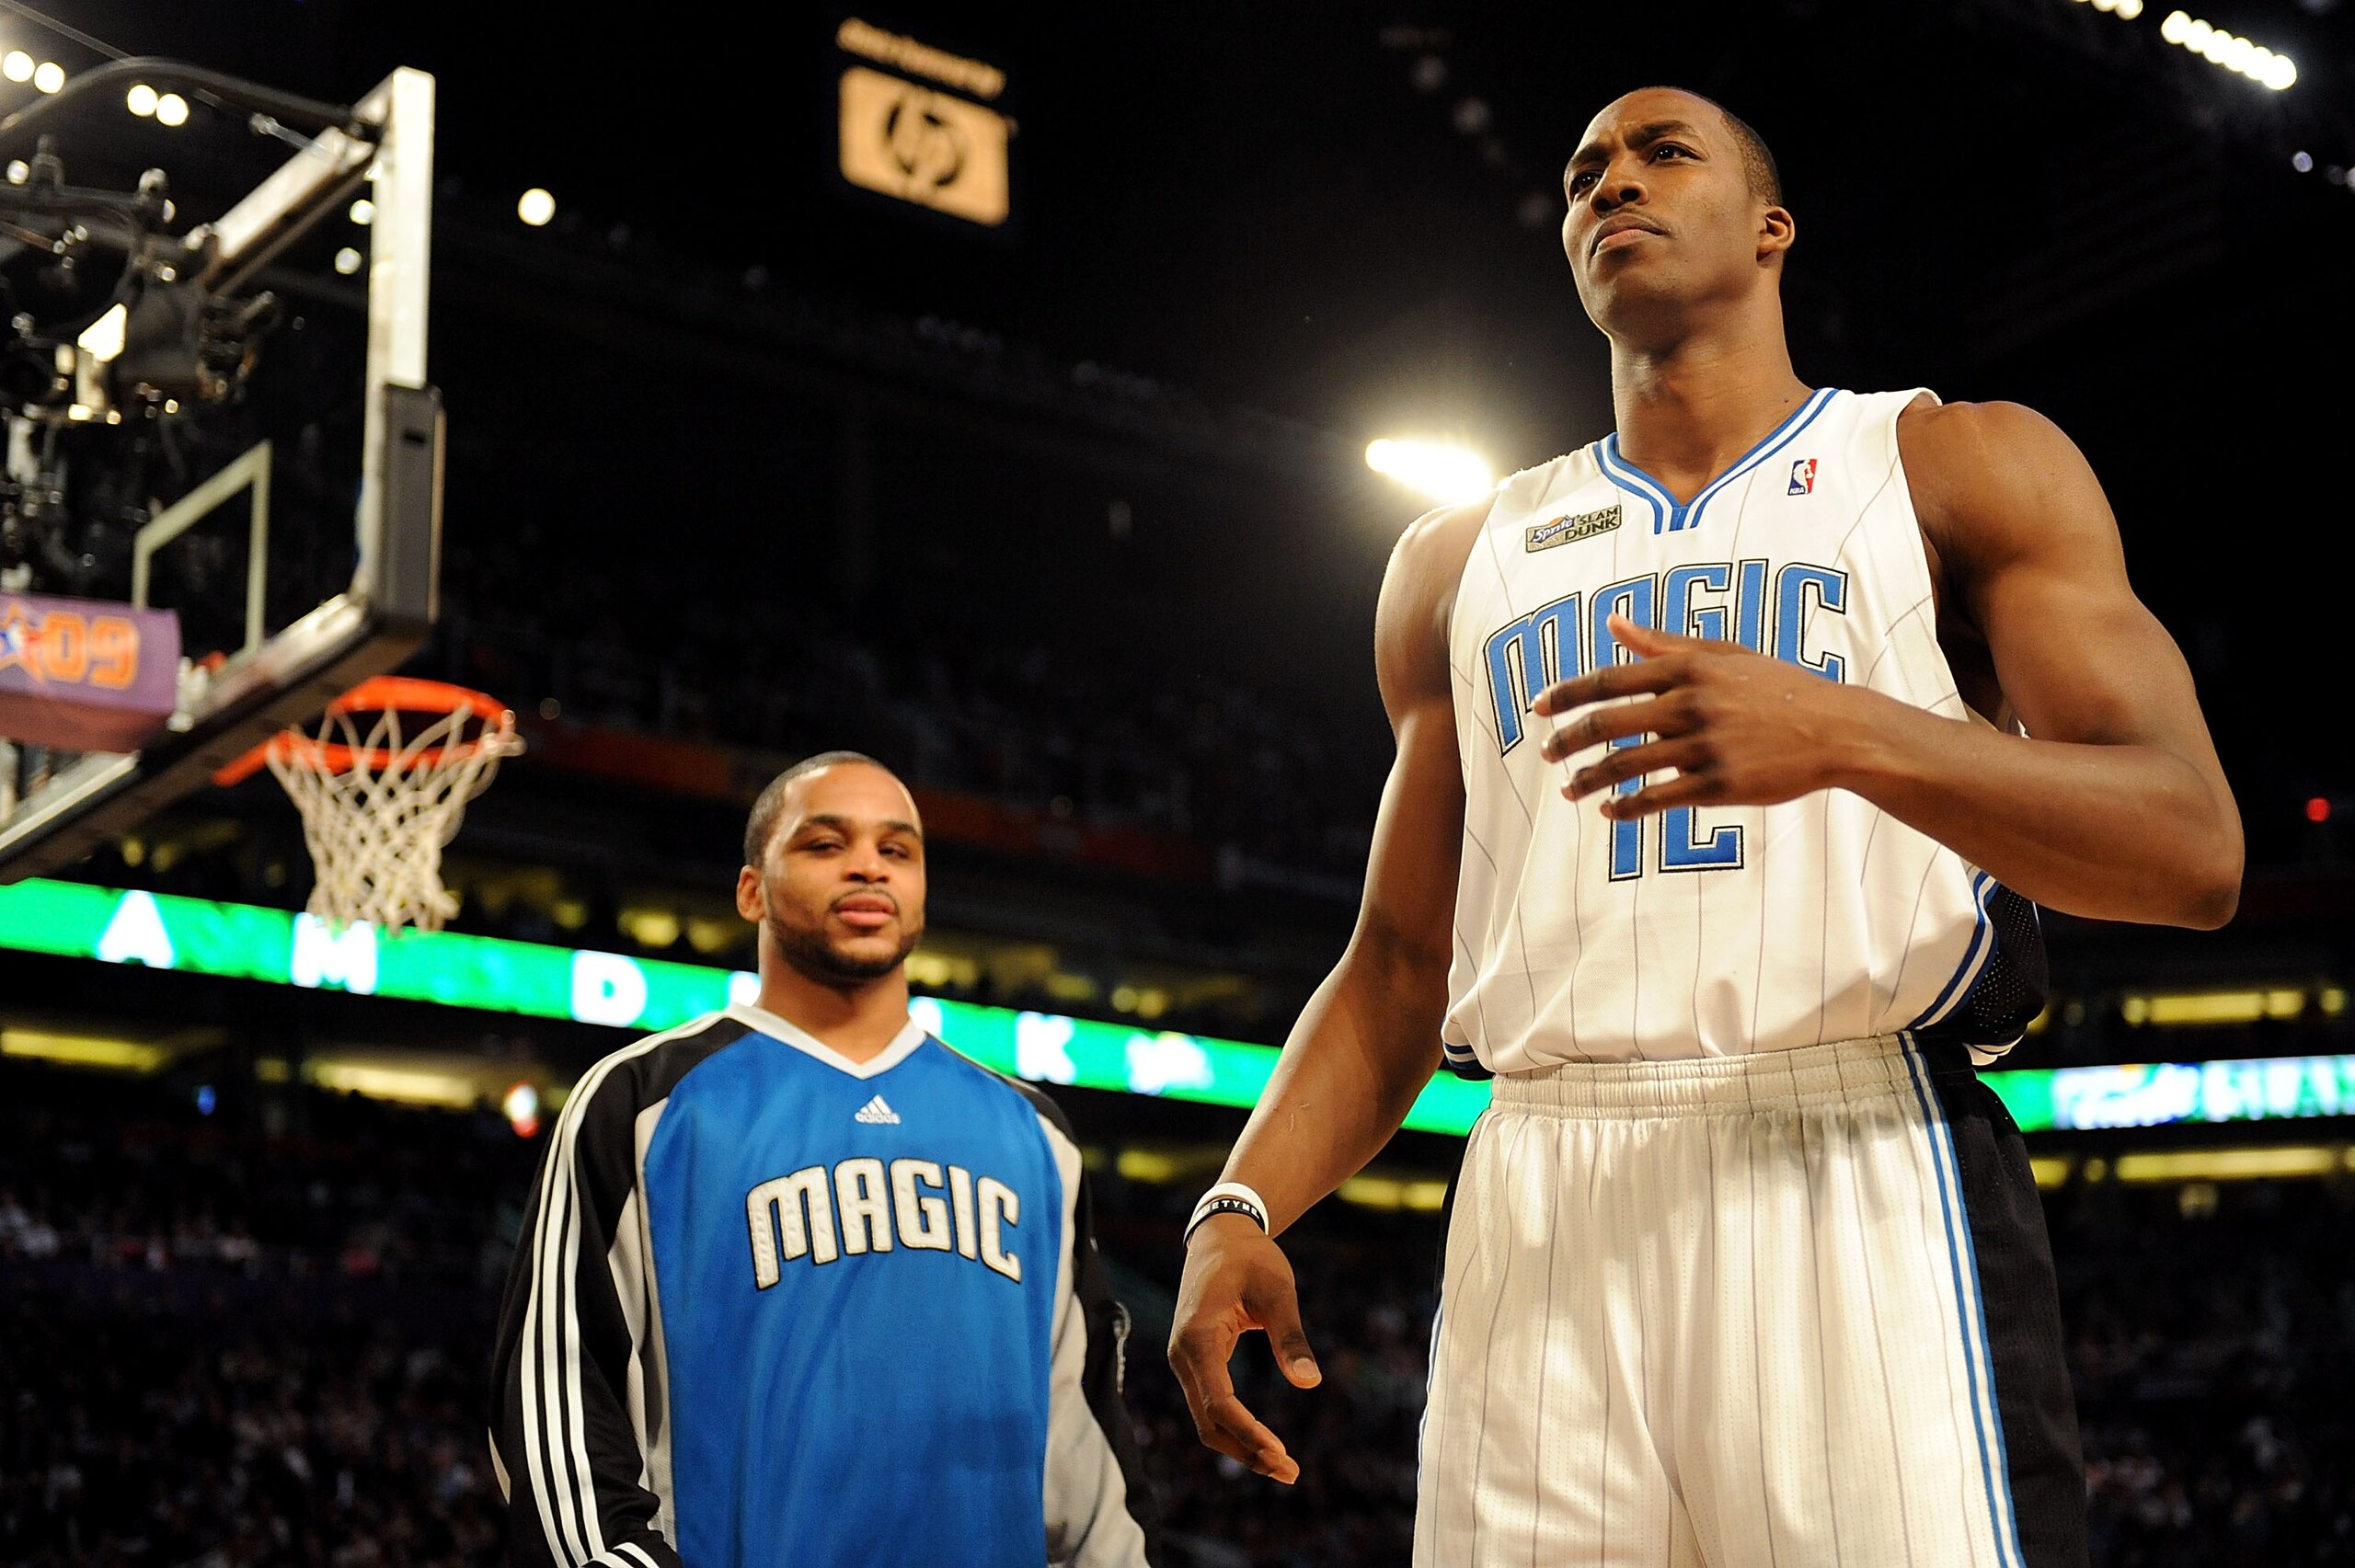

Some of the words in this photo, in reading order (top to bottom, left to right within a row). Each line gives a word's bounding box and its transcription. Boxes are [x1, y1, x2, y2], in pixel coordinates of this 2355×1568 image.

[1533, 518, 1573, 542] Sprite
[1580, 507, 1618, 525] SLAM
[1565, 516, 1617, 541] DUNK
[43, 610, 140, 691] 09
[1483, 558, 1848, 758] MAGIC
[855, 1111, 902, 1126] adidas
[746, 1157, 1022, 1290] MAGIC
